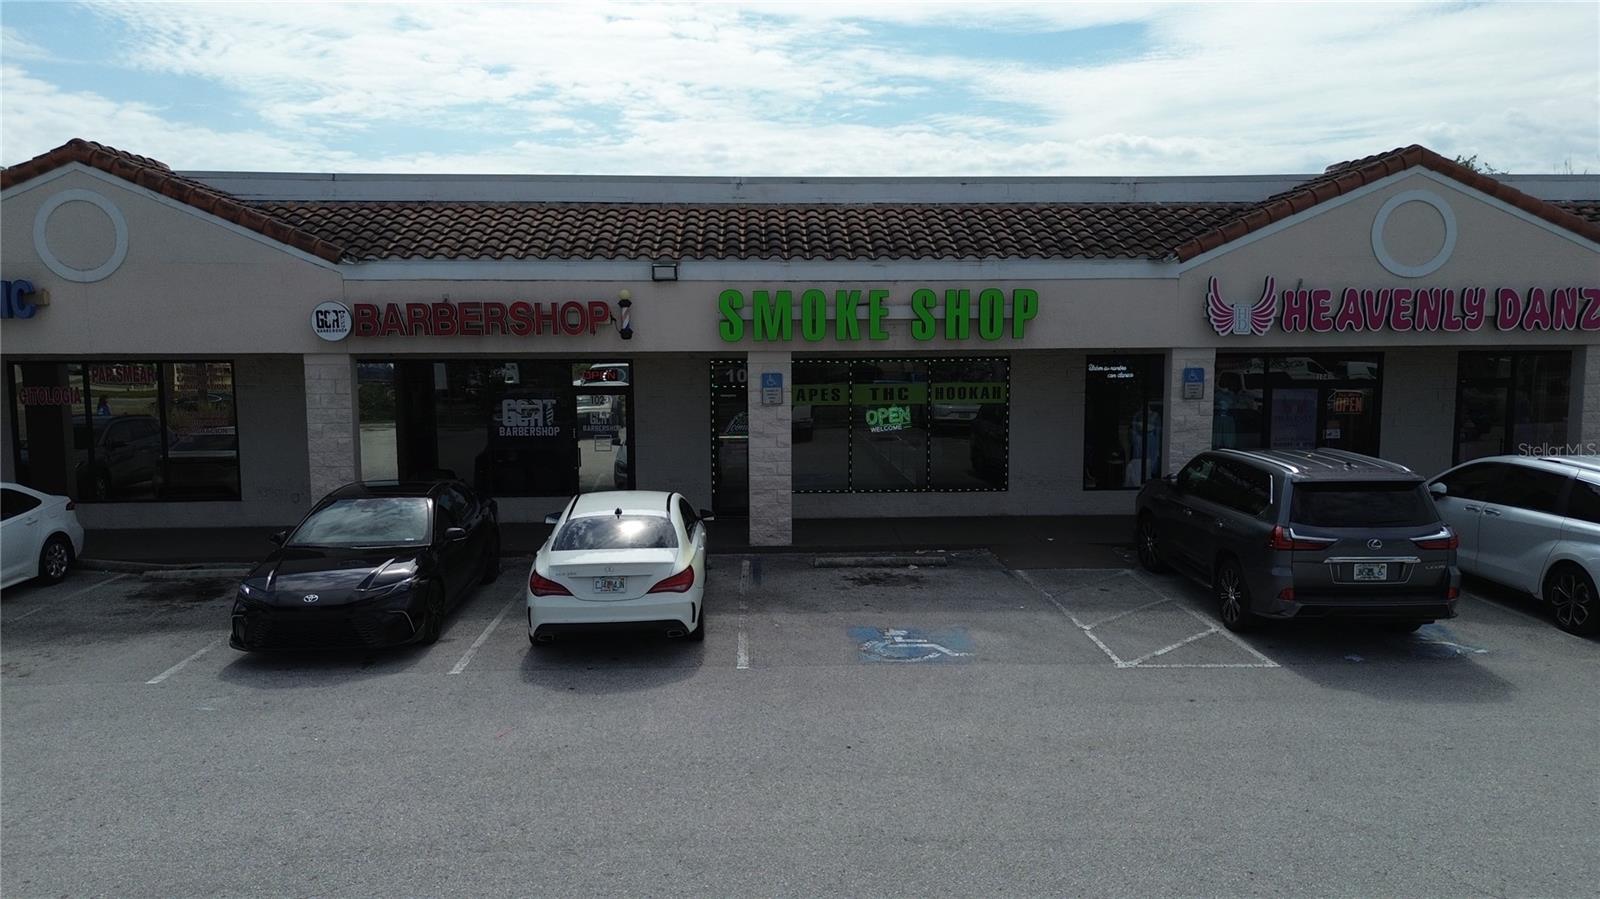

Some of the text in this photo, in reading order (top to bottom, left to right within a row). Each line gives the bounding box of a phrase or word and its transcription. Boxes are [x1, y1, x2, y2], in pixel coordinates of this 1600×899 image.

[718, 287, 1039, 342] SMOKE SHOP
[1281, 286, 1600, 332] HEAVENLY DANZ
[354, 301, 612, 338] BARBERSHOP
[583, 369, 616, 381] OPEN
[726, 368, 748, 383] 10
[796, 387, 842, 402] APES
[869, 387, 910, 401] THC
[935, 386, 1001, 401] HOOKAH
[1336, 397, 1361, 412] OPEN
[865, 405, 911, 426] OPEN
[499, 426, 561, 437] BARBERSHOP
[870, 424, 903, 433] WELCOME
